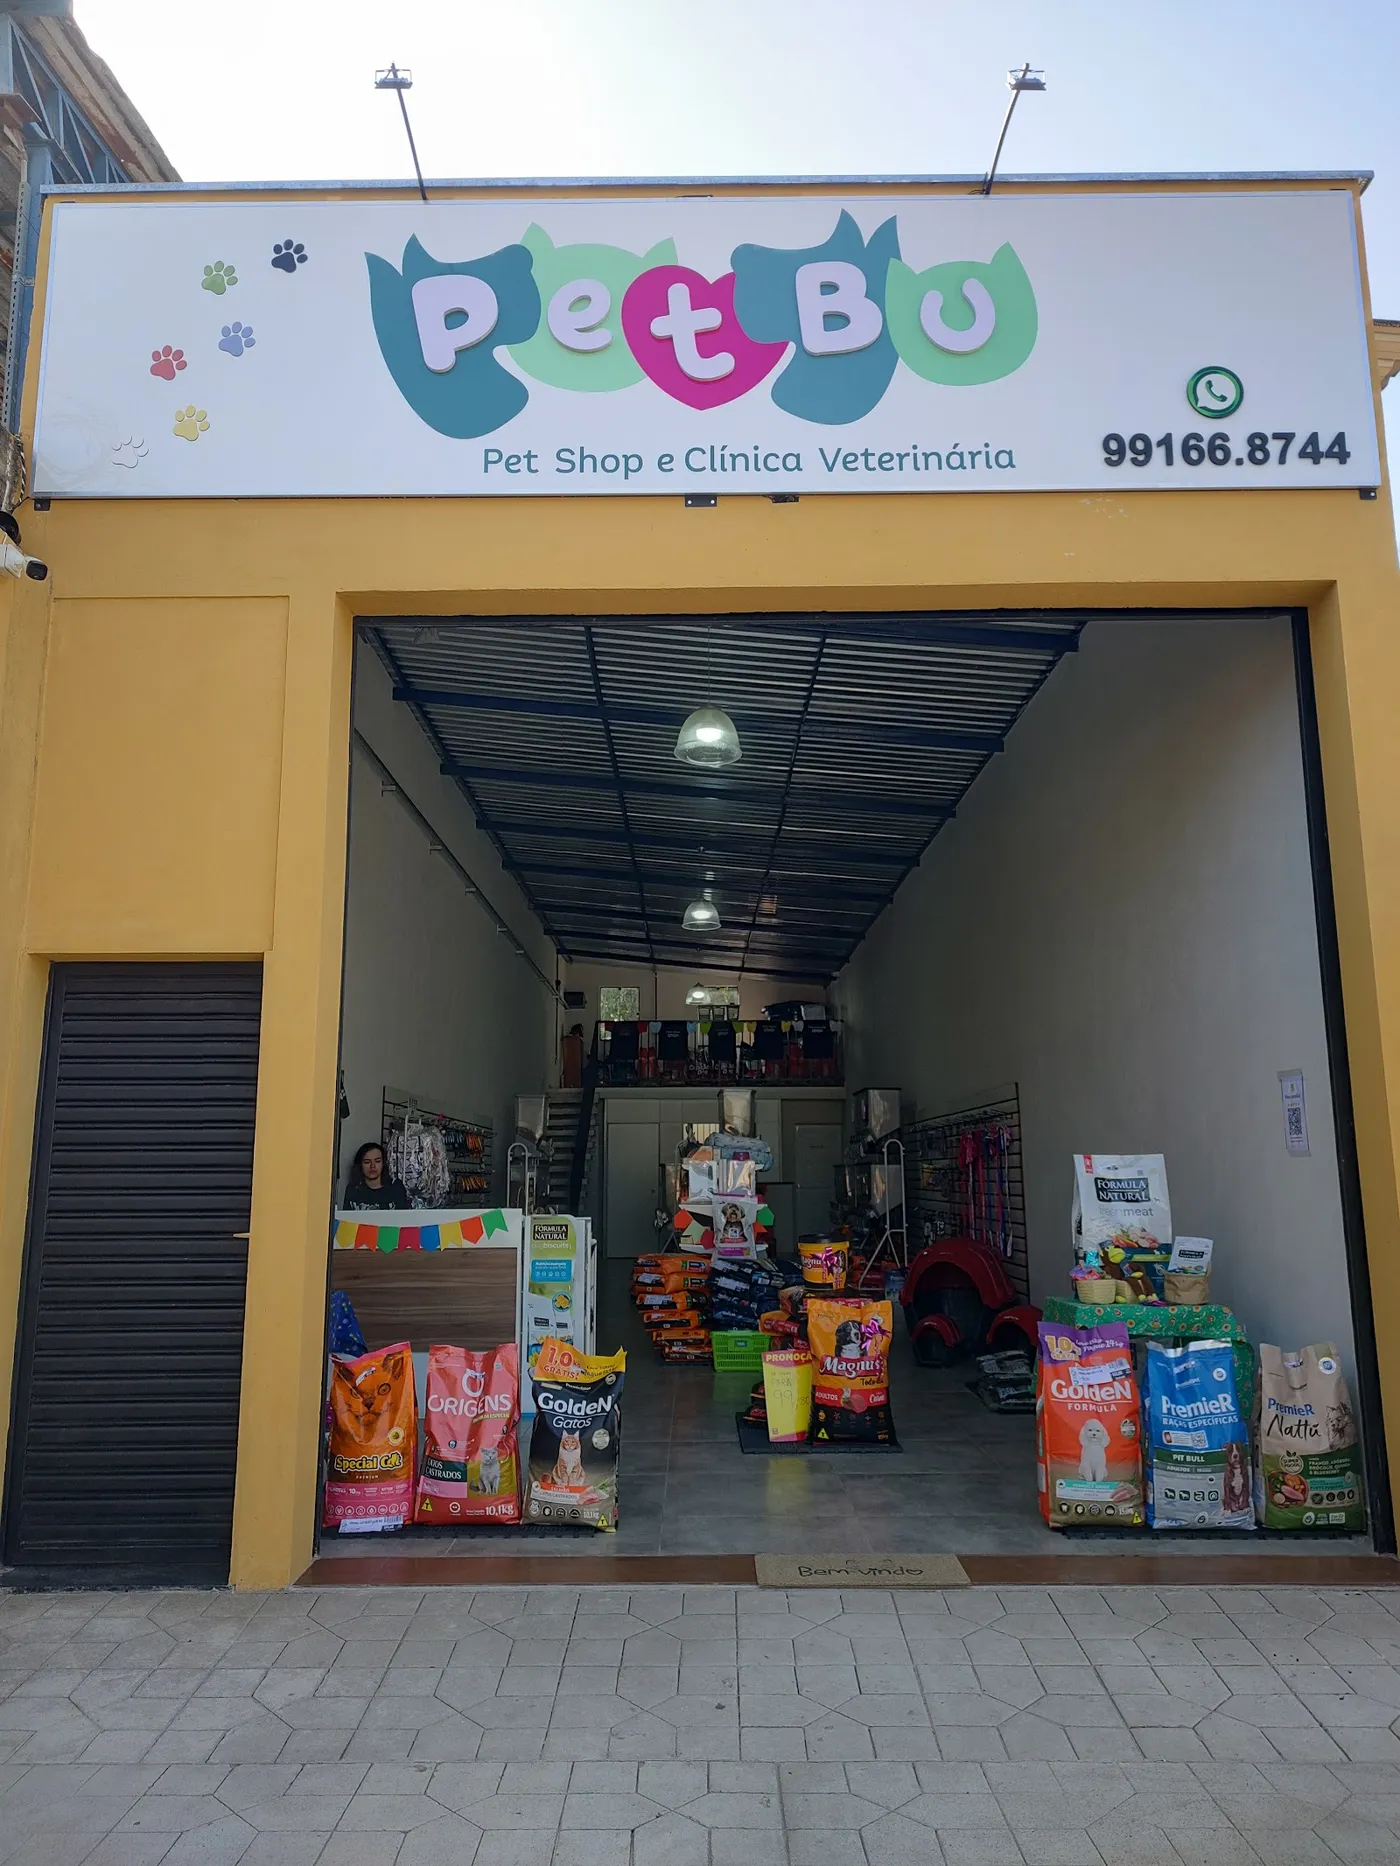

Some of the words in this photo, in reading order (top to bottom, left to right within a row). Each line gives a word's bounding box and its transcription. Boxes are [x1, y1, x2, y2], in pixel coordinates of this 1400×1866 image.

[1102, 431, 1351, 467] 99166.8744
[483, 448, 539, 474] Pet
[555, 446, 644, 480] Shop
[657, 452, 675, 473] e
[684, 444, 803, 473] Clínica
[818, 442, 1016, 473] Veterinária
[1099, 1190, 1149, 1201] NATURAL
[534, 1232, 567, 1240] NATURAL
[819, 1356, 881, 1378] Magnus
[815, 1391, 838, 1401] ADULTOS
[427, 1393, 512, 1418] ORIGENS
[552, 1415, 593, 1429] Gatos
[1162, 1418, 1187, 1428] RAÇAS
[1187, 1415, 1239, 1429] ESPECÍFICAS
[335, 1455, 379, 1473] Special
[1172, 1454, 1185, 1462] PIT
[1185, 1455, 1205, 1463] BULL
[425, 1466, 462, 1480] CASTRADOS
[485, 1504, 514, 1516] 10,1kg
[798, 1565, 849, 1577] Bem
